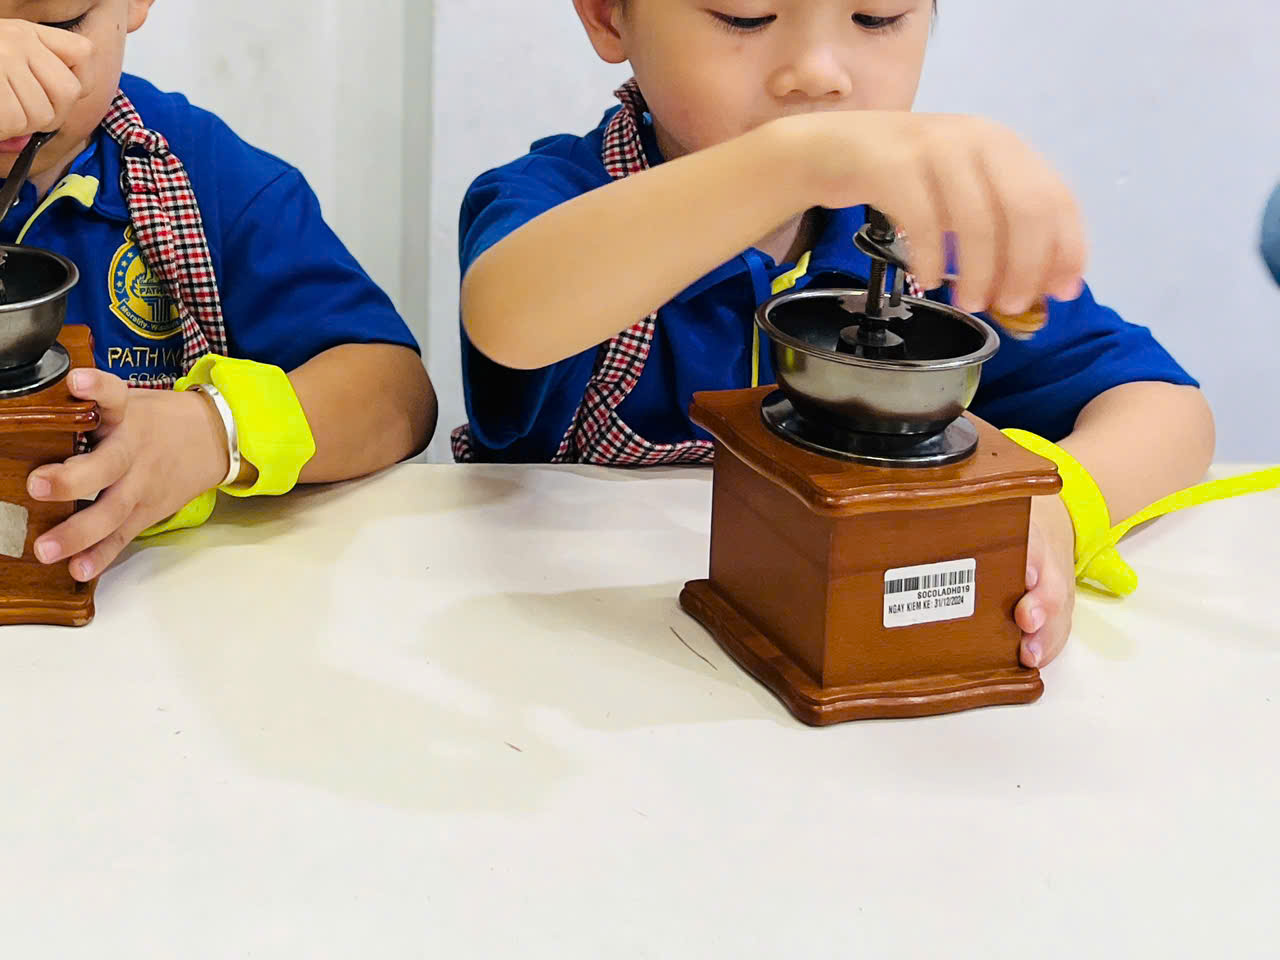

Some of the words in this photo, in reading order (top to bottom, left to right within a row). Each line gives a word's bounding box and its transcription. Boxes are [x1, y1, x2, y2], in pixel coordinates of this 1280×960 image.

[108, 346, 180, 368] PATHW
[888, 604, 905, 615] NGAY
[907, 600, 921, 612] KIEM
